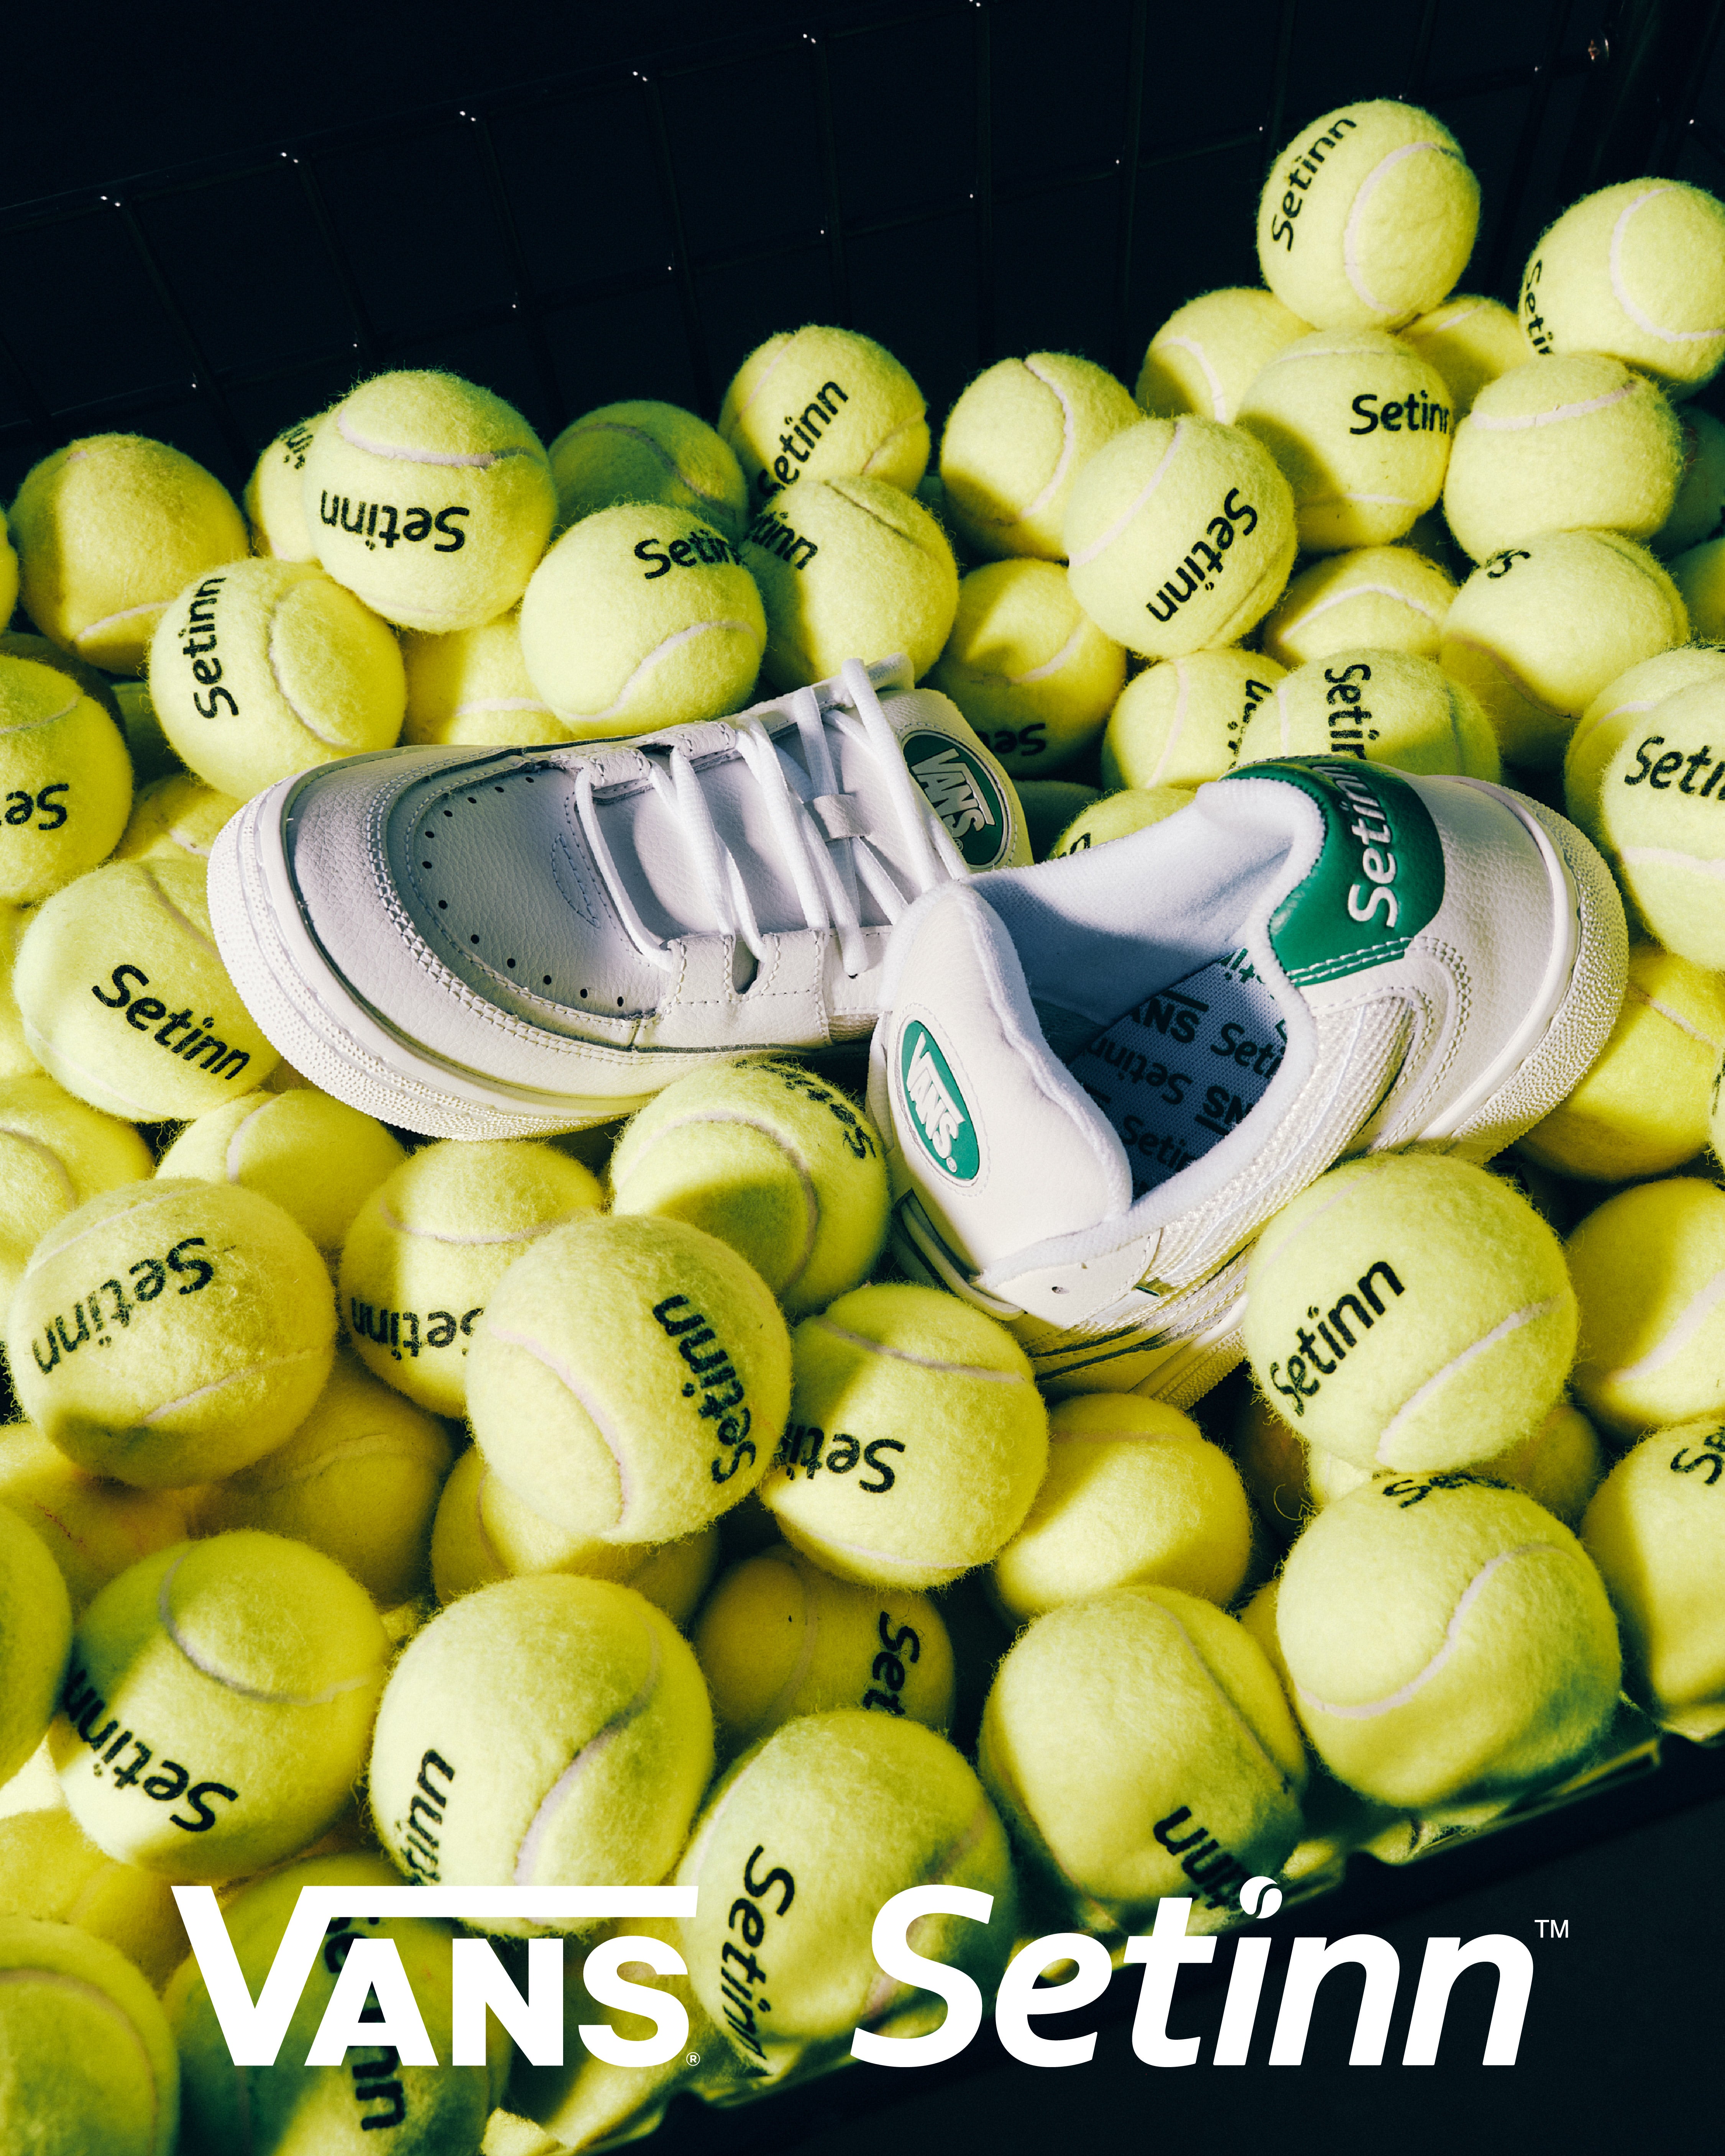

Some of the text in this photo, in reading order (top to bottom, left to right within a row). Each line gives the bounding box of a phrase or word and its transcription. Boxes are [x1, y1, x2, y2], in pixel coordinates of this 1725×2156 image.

[1272, 117, 1357, 252] Setinn
[1525, 259, 1554, 355] Seti
[320, 489, 470, 553] Setinn
[1145, 488, 1258, 622] Setinn
[178, 576, 240, 719] Setinn
[1312, 766, 1398, 928] Setinn
[92, 964, 250, 1080] Setinn
[1209, 1022, 1286, 1079] Seti
[32, 1237, 214, 1374] Setinn
[1270, 1261, 1405, 1417] Setinn
[653, 1294, 756, 1484] Setinn
[774, 1422, 906, 1493] Seti
[61, 1668, 239, 1832] Setinn
